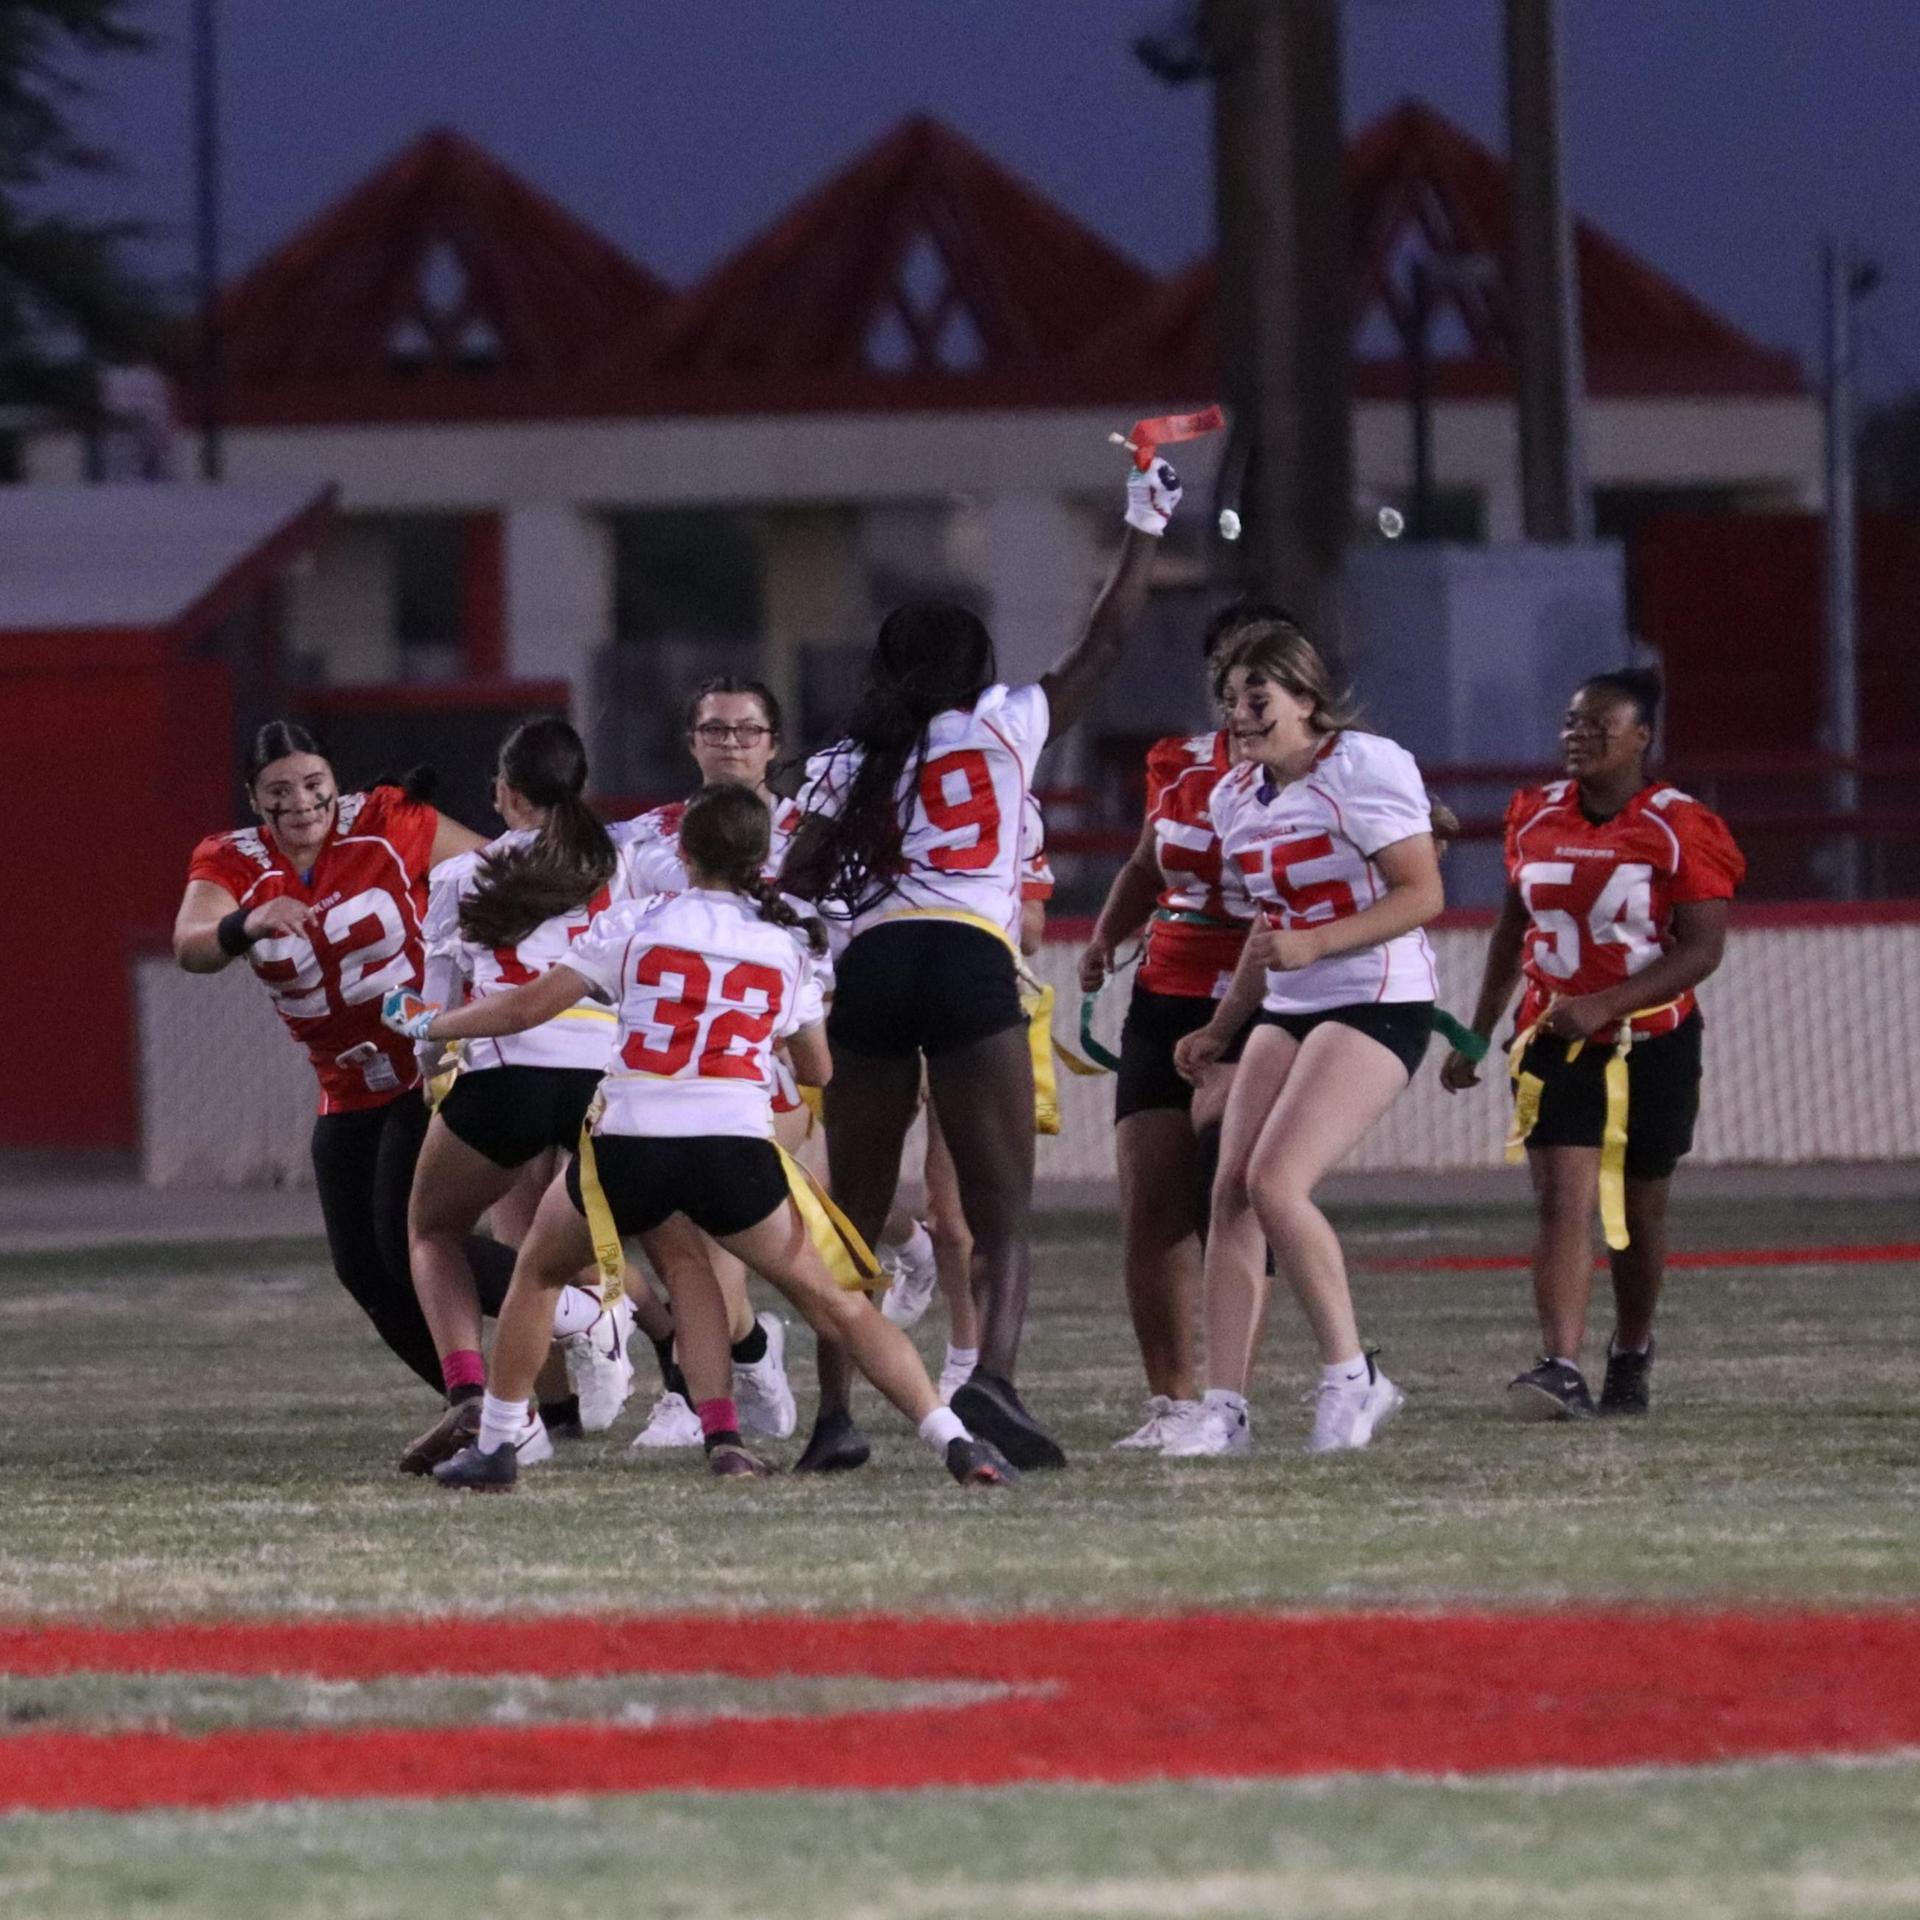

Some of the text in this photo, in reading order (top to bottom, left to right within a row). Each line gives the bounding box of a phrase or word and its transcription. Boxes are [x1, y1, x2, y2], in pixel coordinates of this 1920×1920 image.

[252, 887, 417, 1019] 22
[1519, 861, 1665, 980] 54
[621, 946, 784, 1081] 32
